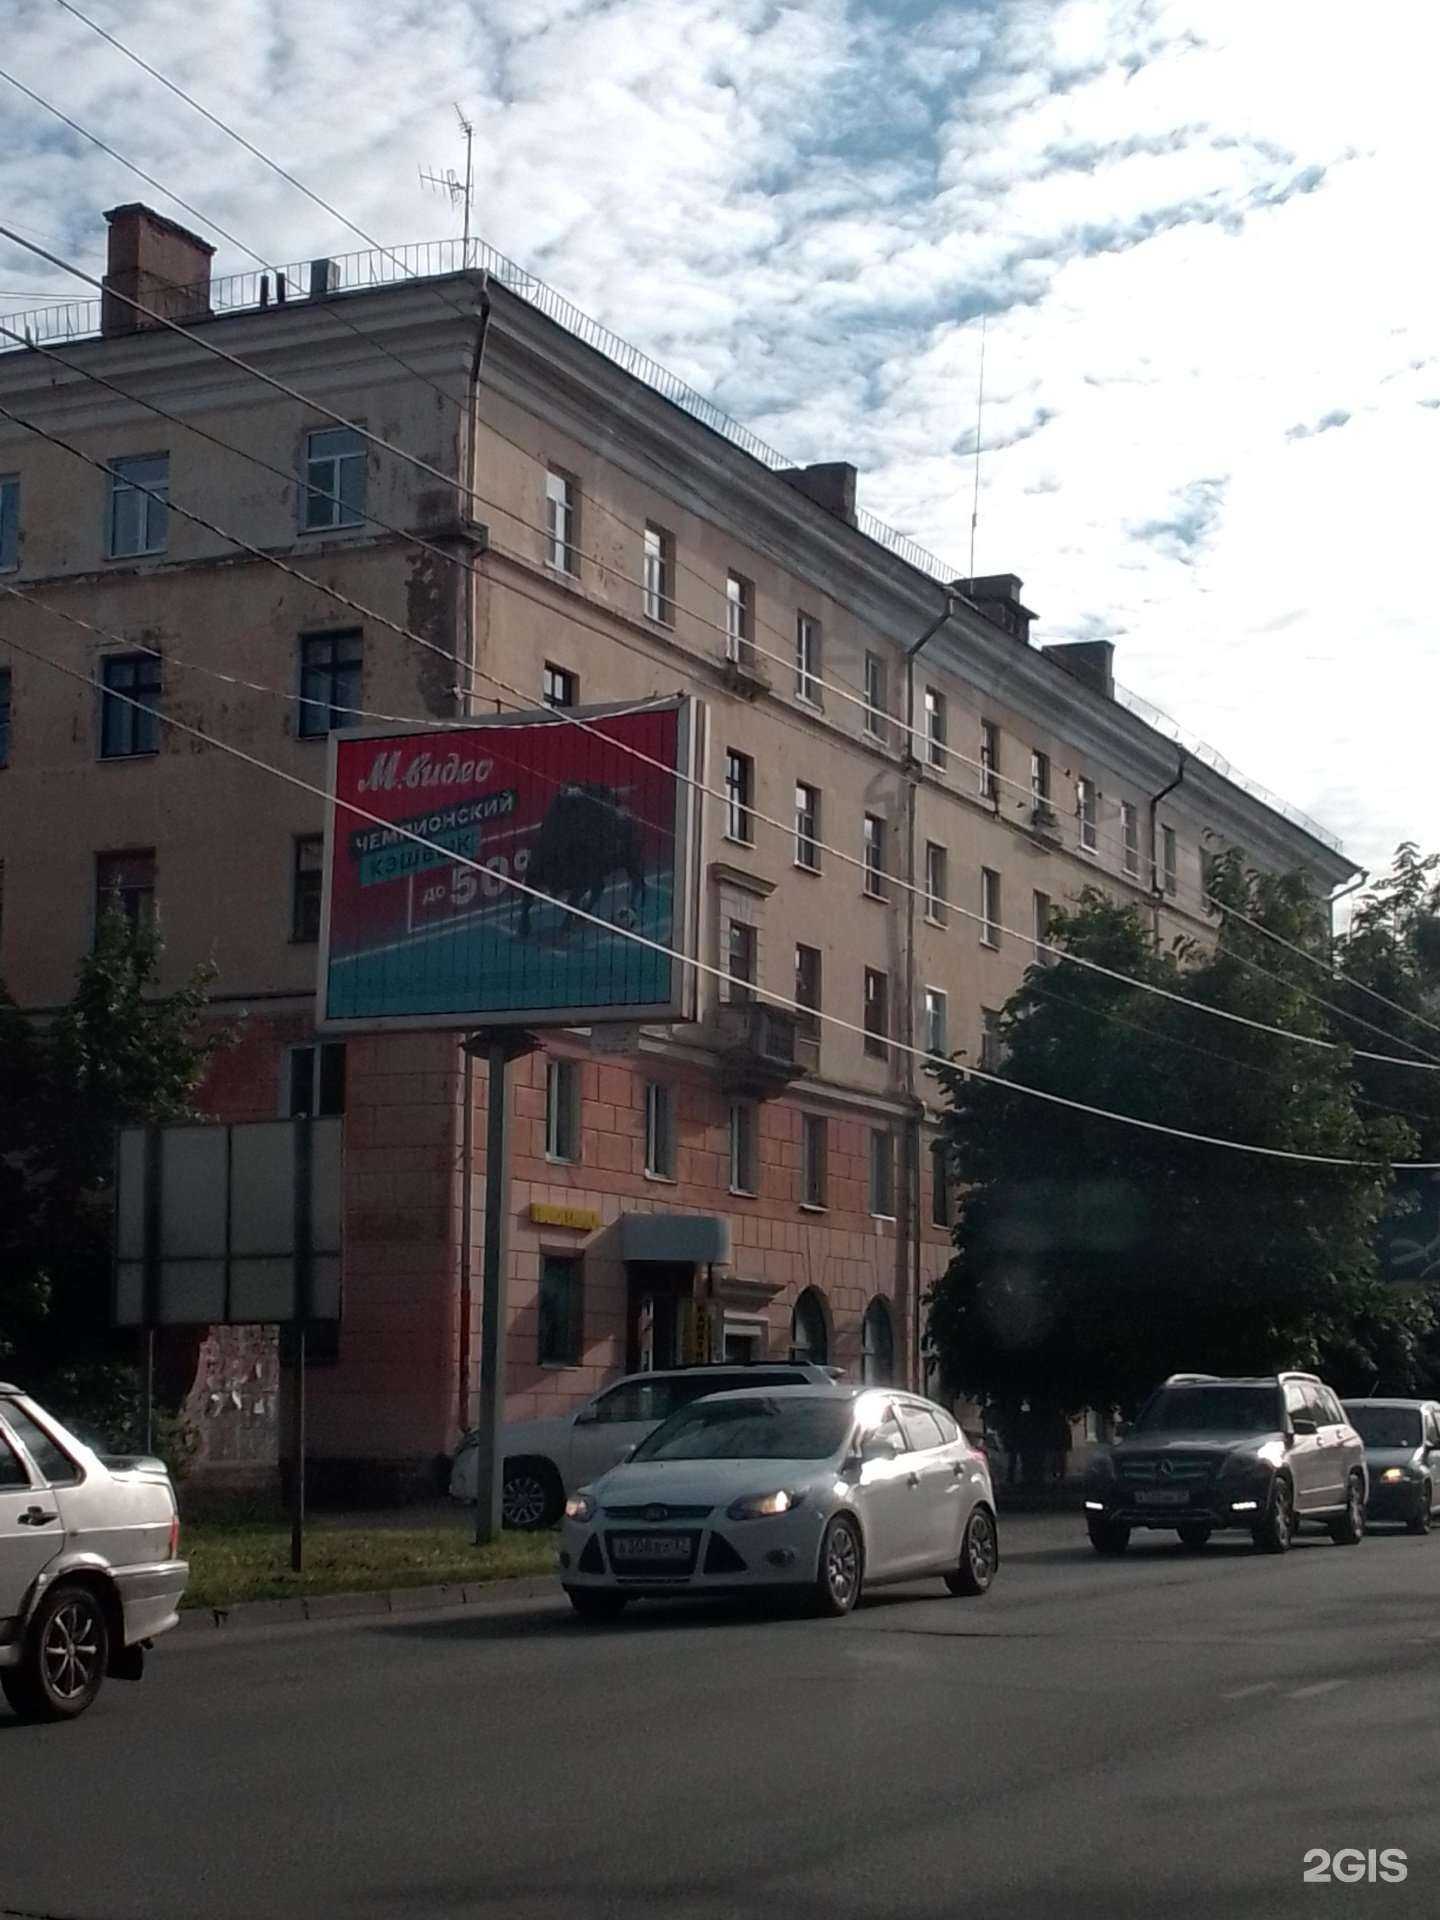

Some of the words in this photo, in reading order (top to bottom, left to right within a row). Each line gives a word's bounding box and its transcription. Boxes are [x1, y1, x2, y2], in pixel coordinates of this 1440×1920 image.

[358, 751, 494, 792] М.видео
[356, 791, 514, 851] ЧЕМПИОНСКИЙ
[372, 834, 472, 876] КЭШБК
